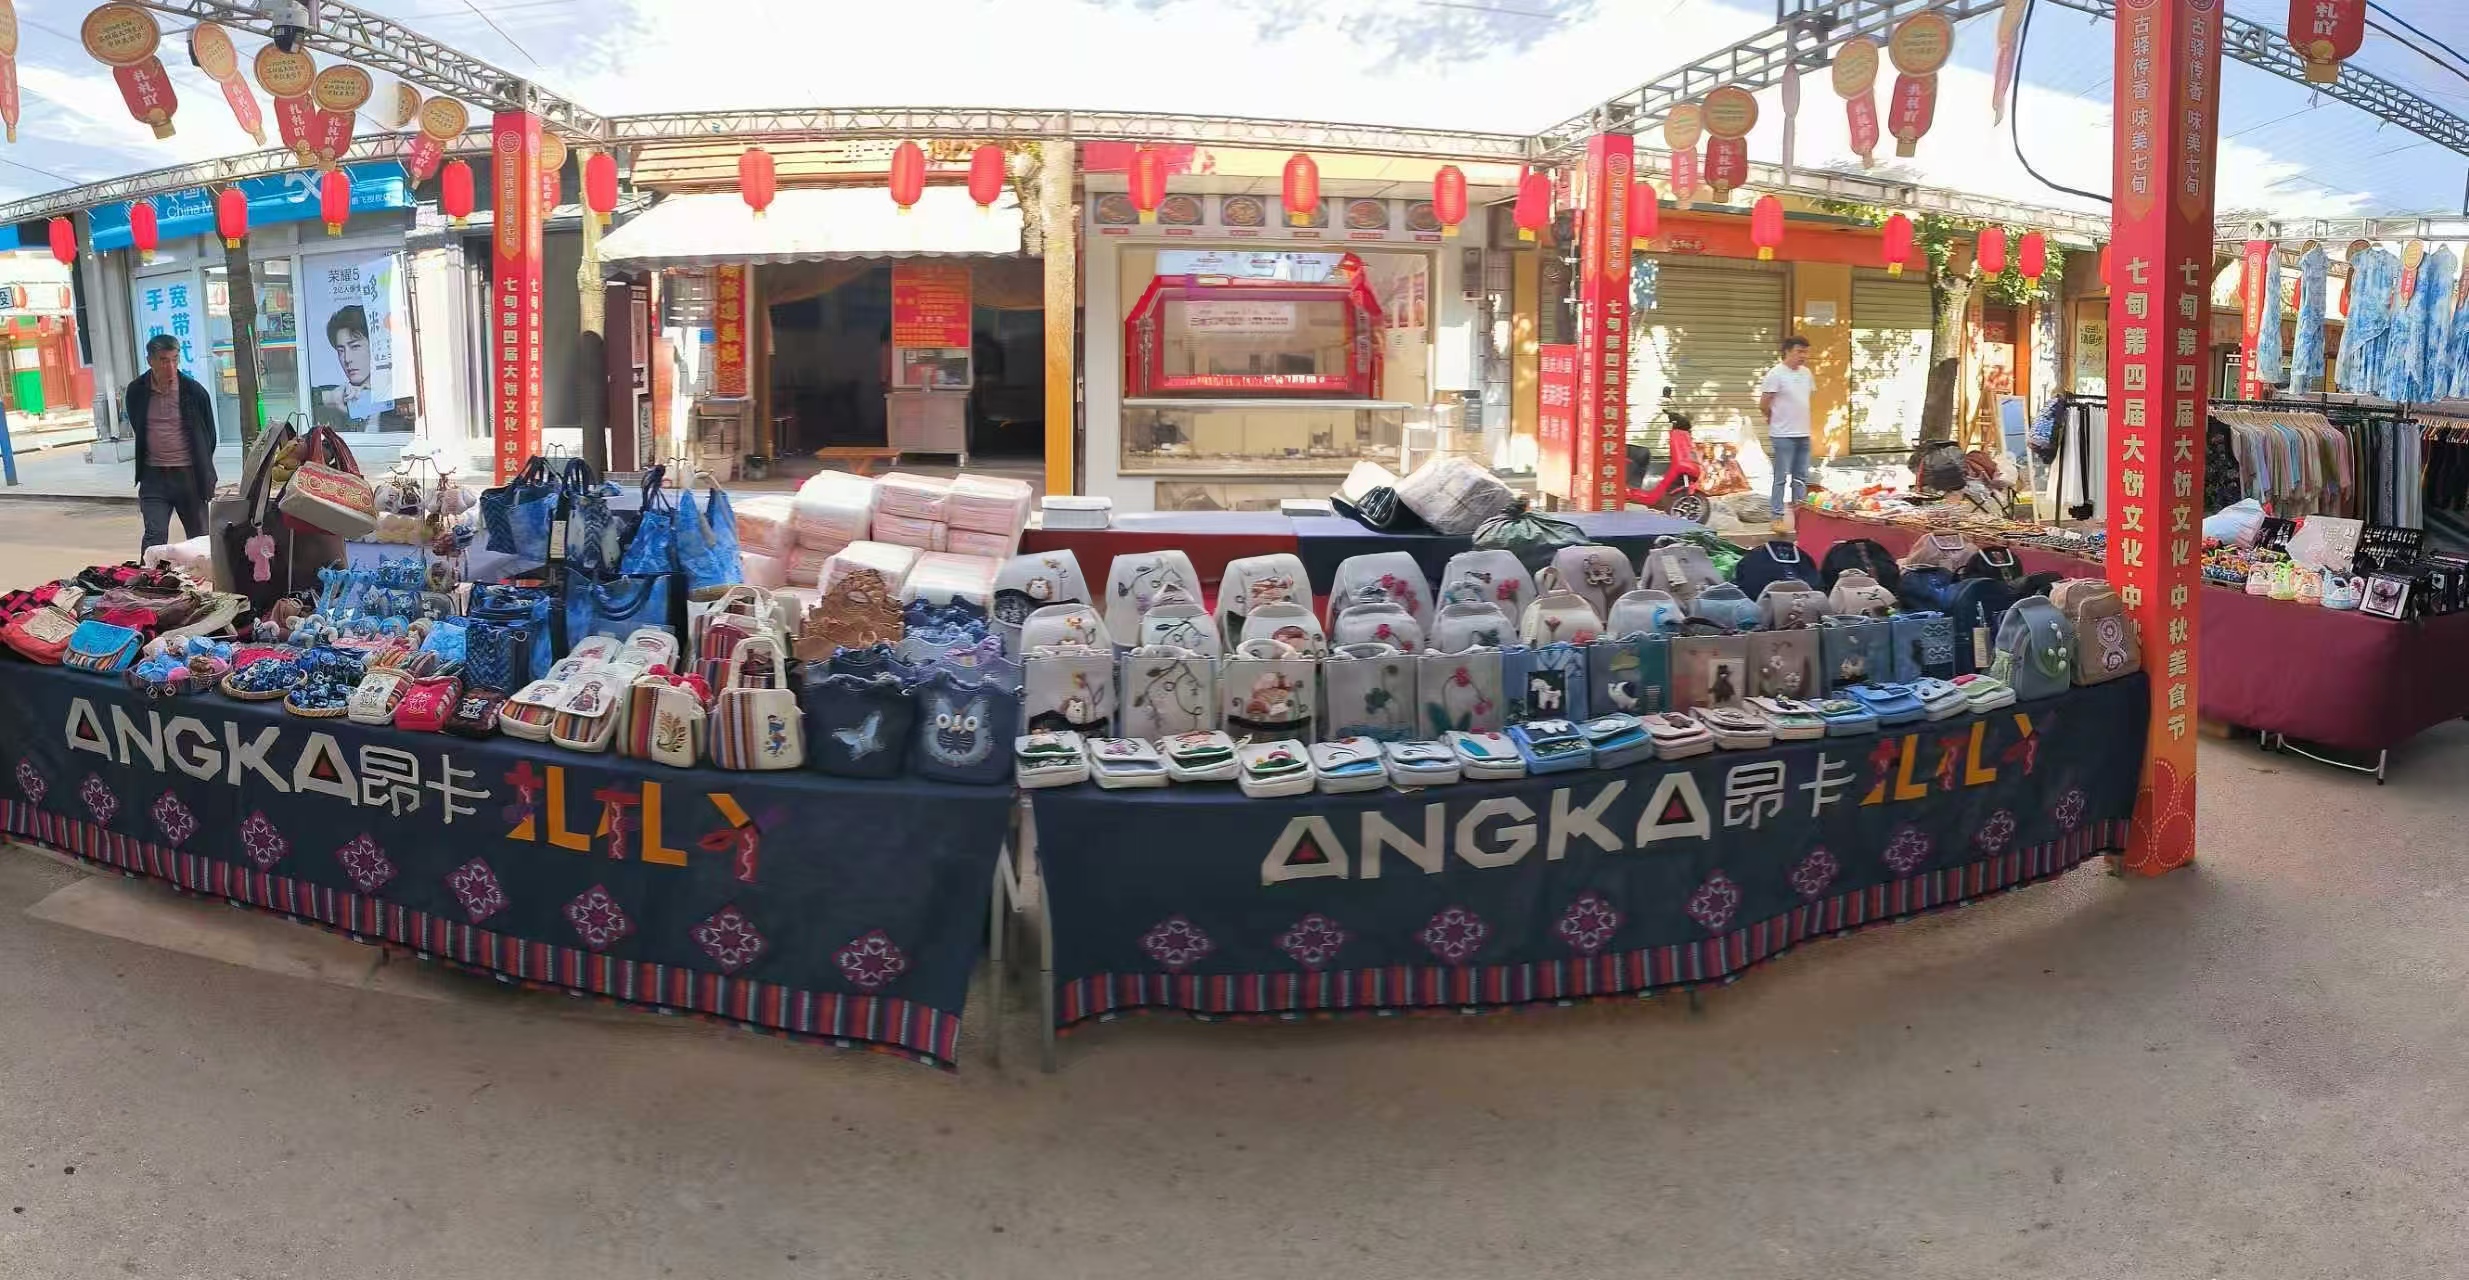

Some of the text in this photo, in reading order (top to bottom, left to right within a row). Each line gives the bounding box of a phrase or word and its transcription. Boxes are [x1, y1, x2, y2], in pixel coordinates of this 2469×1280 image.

[2131, 15, 2151, 194] 古驿传香 味美七甸
[2185, 17, 2208, 196] 古驿传香 味美七甸
[167, 202, 199, 219] China
[2168, 258, 2200, 741] 七甸第四届大饼文化·中秋美食节
[66, 697, 359, 806] ANGKA
[359, 743, 491, 826] 昂卡
[1260, 772, 1711, 886] ANGKA
[1724, 752, 1857, 829] 昂卡
